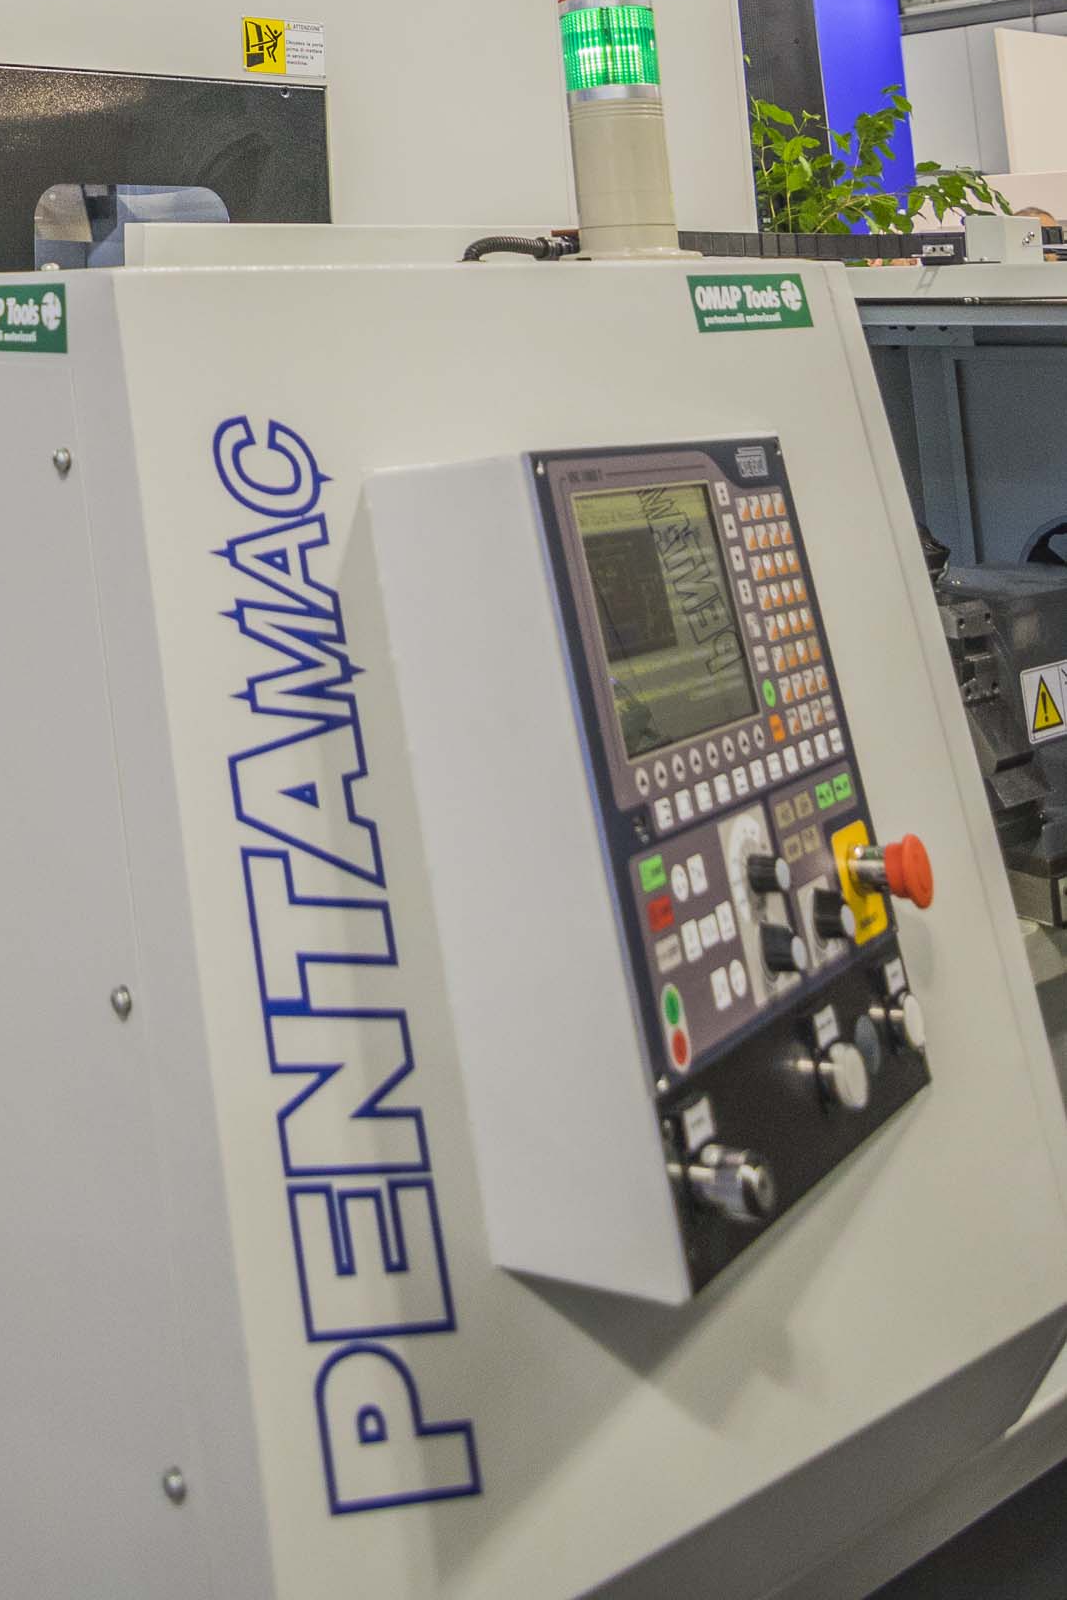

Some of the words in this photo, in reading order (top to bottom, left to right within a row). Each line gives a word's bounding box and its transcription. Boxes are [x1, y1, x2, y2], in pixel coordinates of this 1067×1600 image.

[6, 297, 39, 326] Tools
[695, 285, 742, 310] OMAP
[742, 285, 781, 309] Tools
[210, 415, 483, 1516] PENTAMAC
